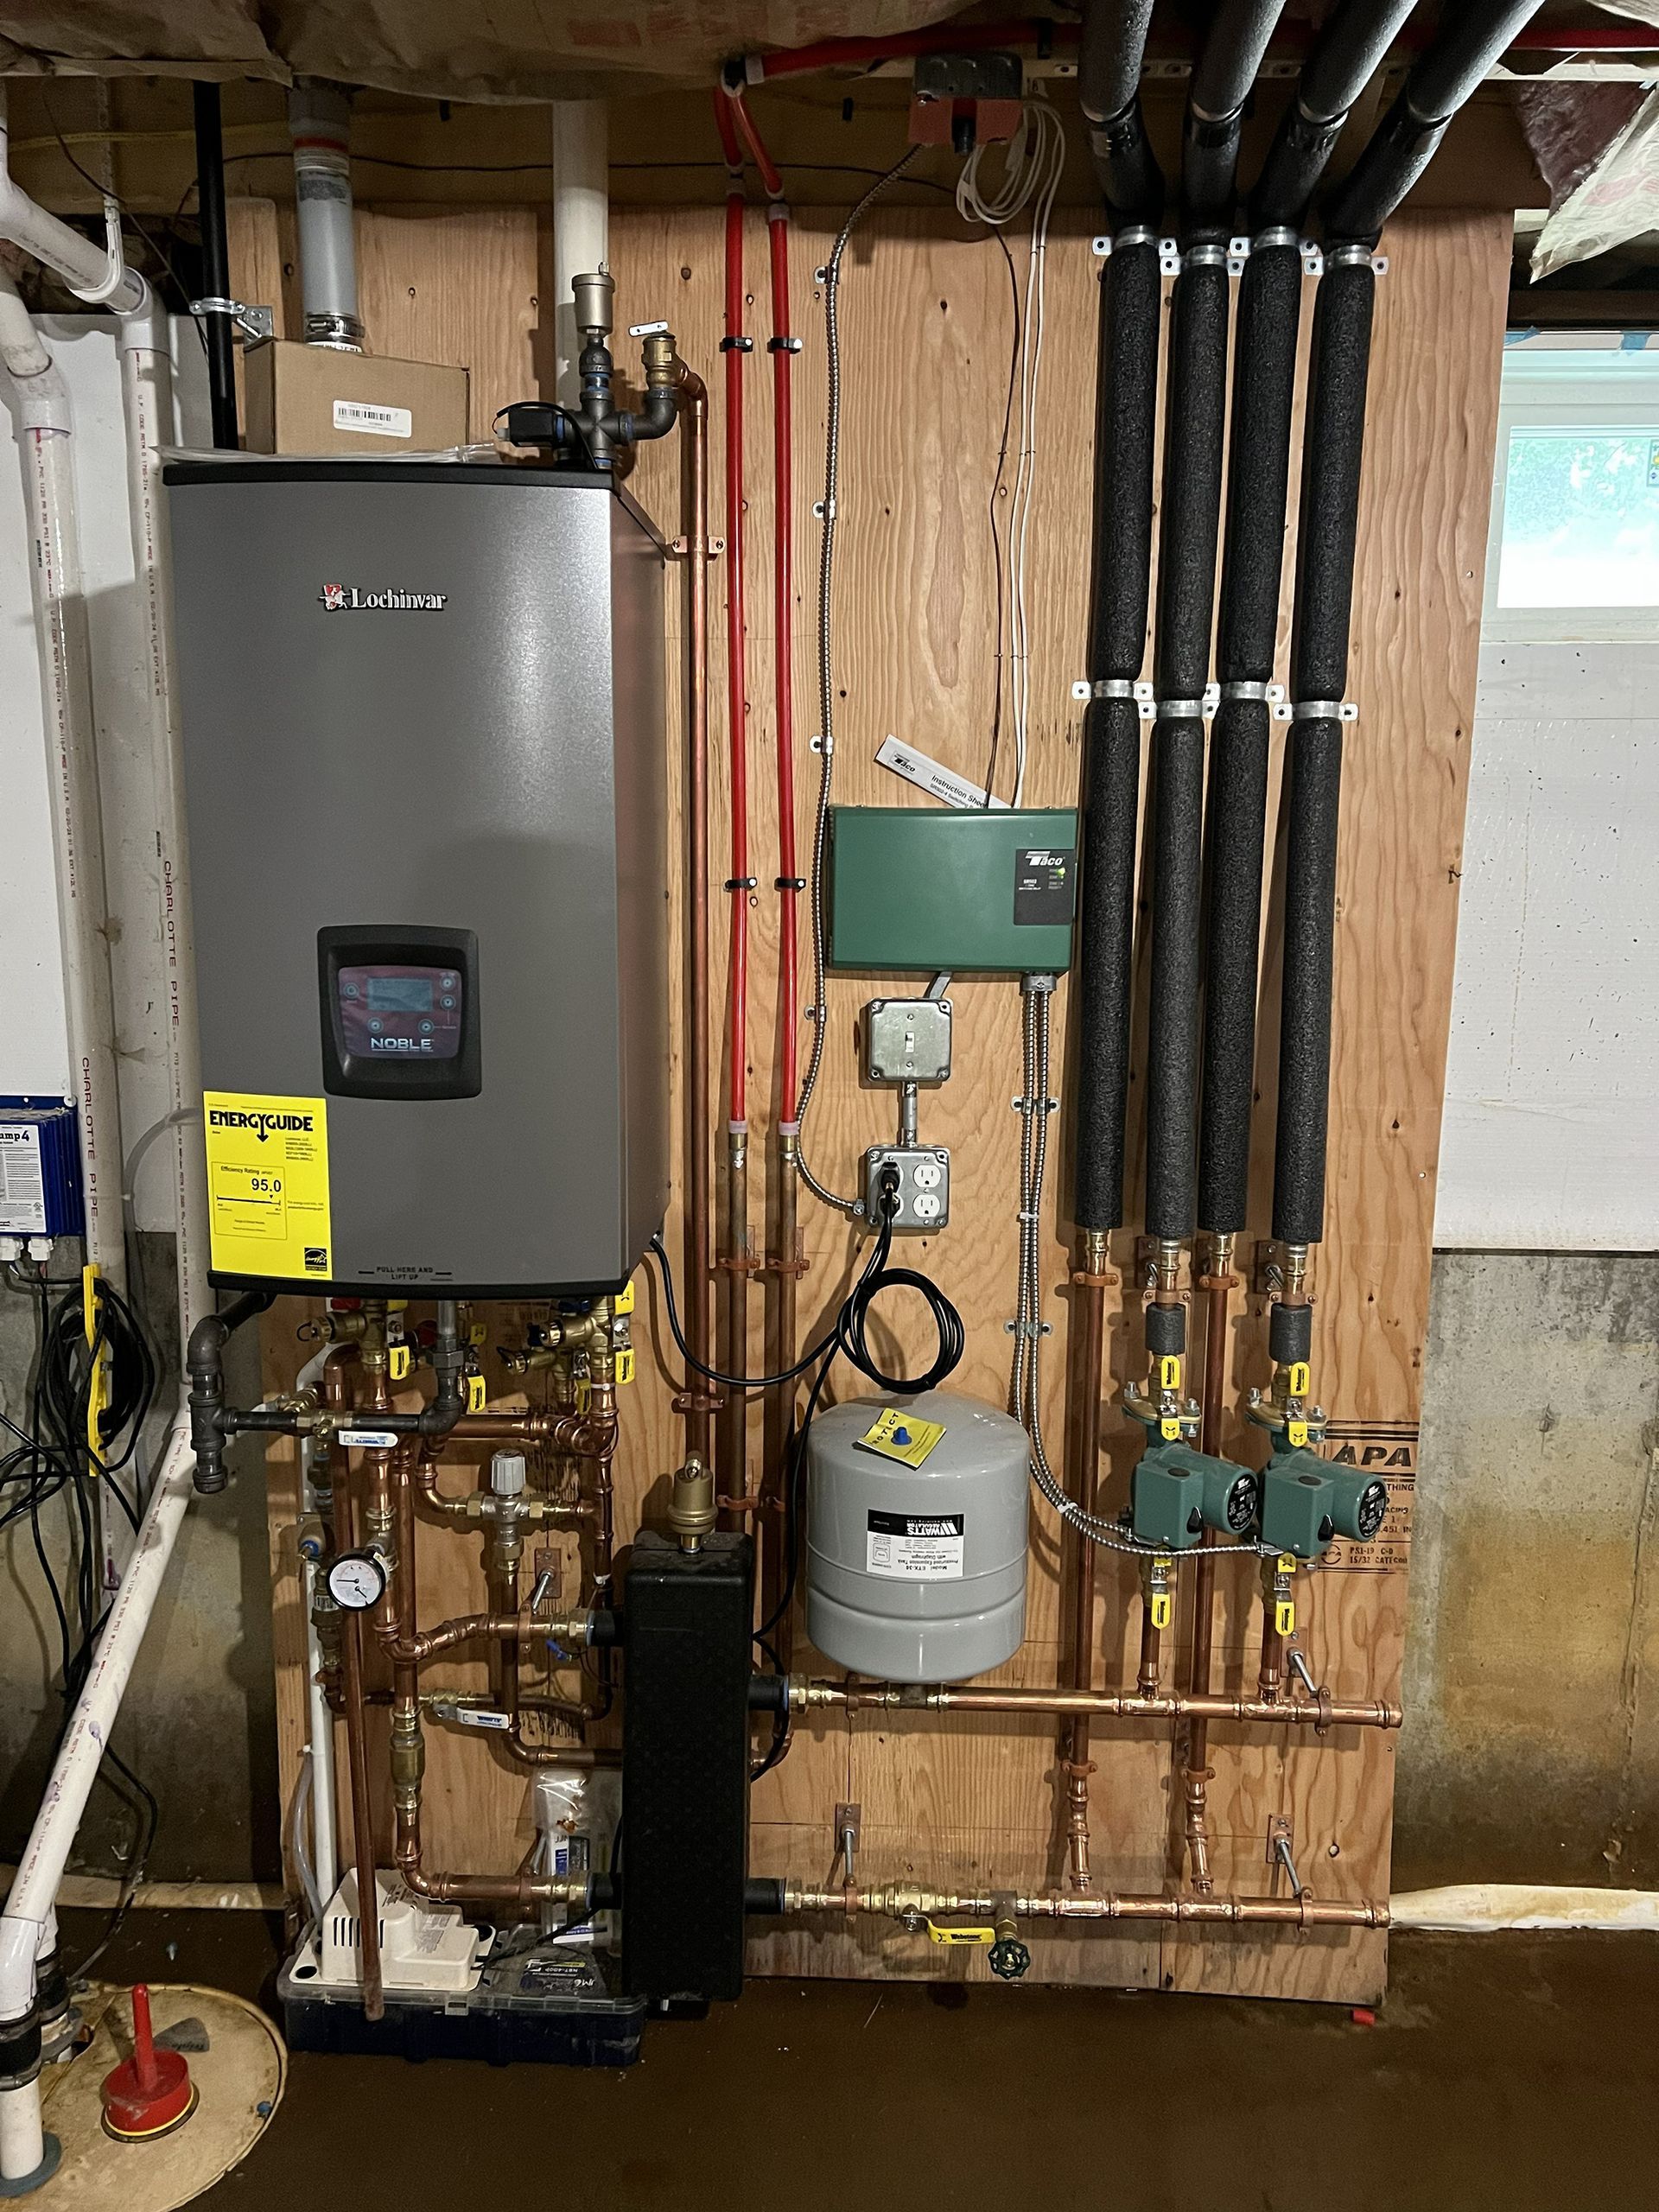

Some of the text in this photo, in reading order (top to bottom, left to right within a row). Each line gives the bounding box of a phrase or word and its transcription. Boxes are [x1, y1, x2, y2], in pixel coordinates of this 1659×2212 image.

[350, 587, 447, 609] Lochinvar
[893, 753, 916, 772] Taco
[931, 774, 968, 799] Instruction
[1025, 851, 1064, 867] Taco
[164, 861, 180, 1027] CHARLOTTE PIPE
[371, 1037, 433, 1049] NOBLE
[209, 1109, 315, 1133] ENERGYGUIDE
[83, 1057, 99, 1217] CHARLOTTE PIPE
[220, 1165, 260, 1177] Efficiency Rating
[251, 1178, 283, 1192] 95.0
[1332, 1445, 1412, 1467] APA
[1386, 1483, 1415, 1491] THING
[906, 1527, 941, 1535] WATTS
[1380, 1525, 1398, 1534] .451
